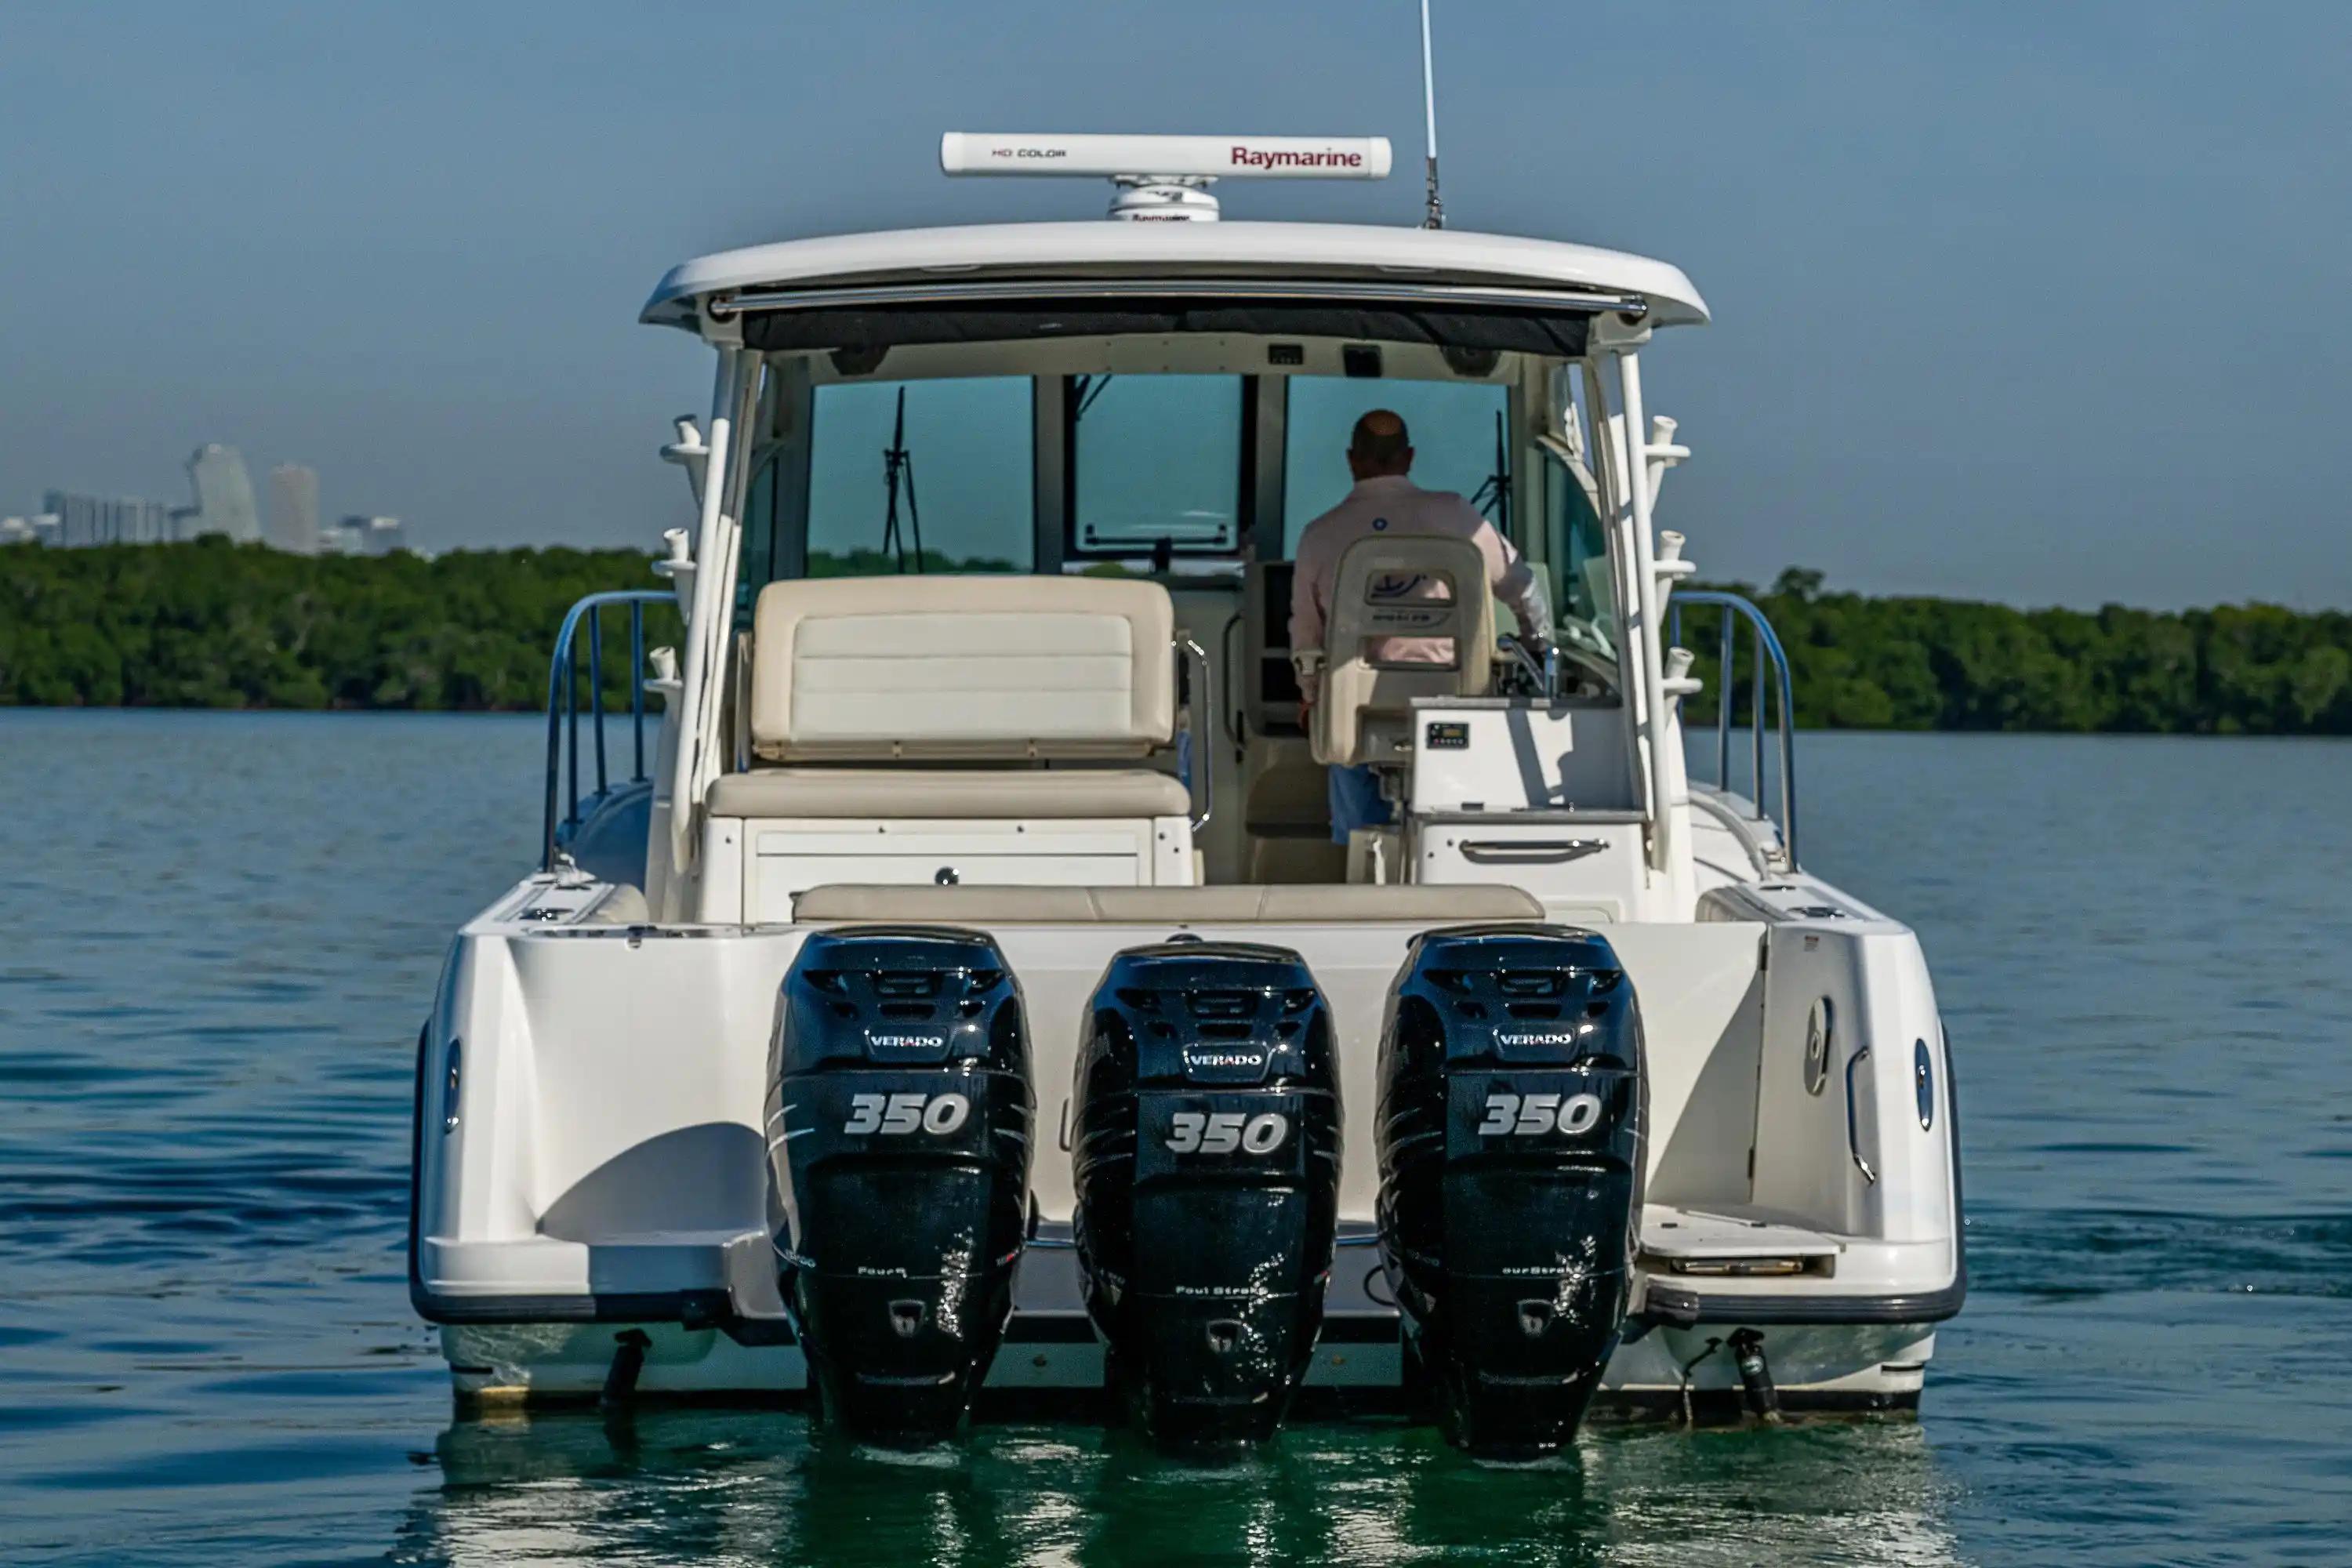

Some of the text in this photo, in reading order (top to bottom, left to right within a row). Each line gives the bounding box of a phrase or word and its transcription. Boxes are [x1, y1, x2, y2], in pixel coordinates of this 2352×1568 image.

[1017, 148, 1067, 158] COLOR
[1231, 146, 1362, 170] Raymarine
[869, 1035, 944, 1048] VERADO
[1499, 1033, 1572, 1045] VERADO
[1188, 1054, 1262, 1066] VERADO
[843, 1093, 970, 1135] 350
[1478, 1093, 1602, 1135] 350
[1165, 1112, 1288, 1155] 350
